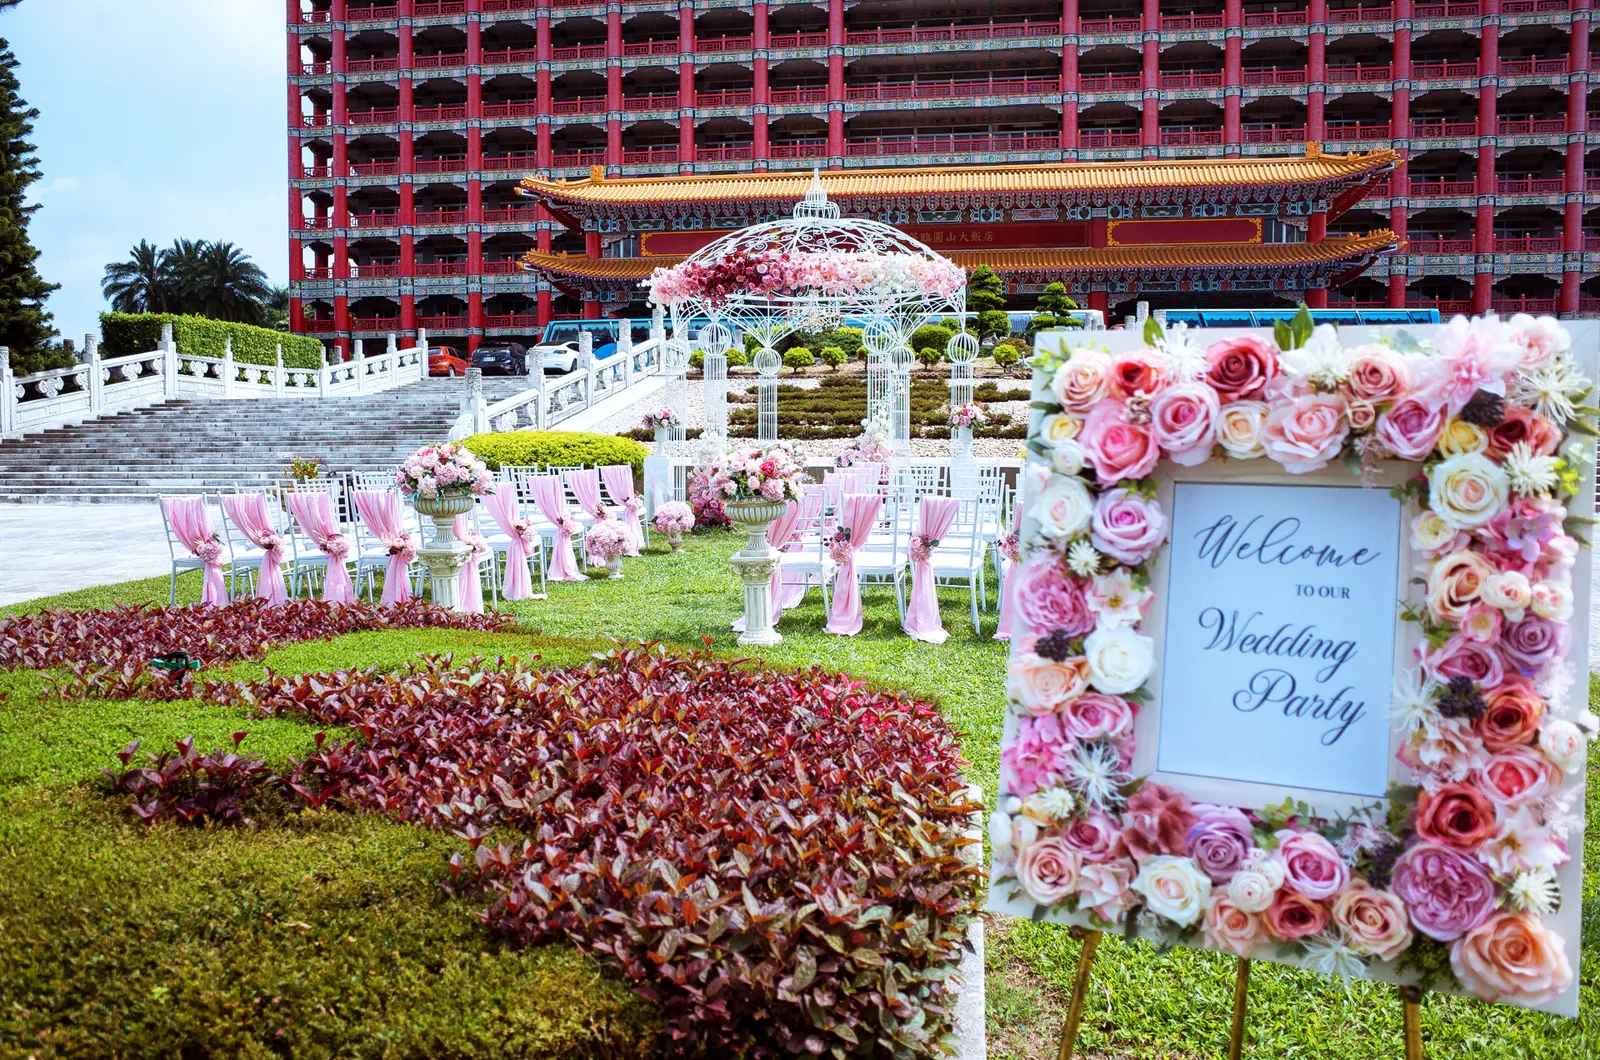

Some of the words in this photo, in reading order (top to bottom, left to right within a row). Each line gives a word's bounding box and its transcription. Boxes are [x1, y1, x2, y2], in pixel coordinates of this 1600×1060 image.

[1193, 514, 1381, 569] Welcome
[1296, 584, 1315, 598] TO
[1318, 585, 1351, 600] OUR
[1198, 607, 1358, 683] Wedding
[1232, 668, 1366, 746] Party
